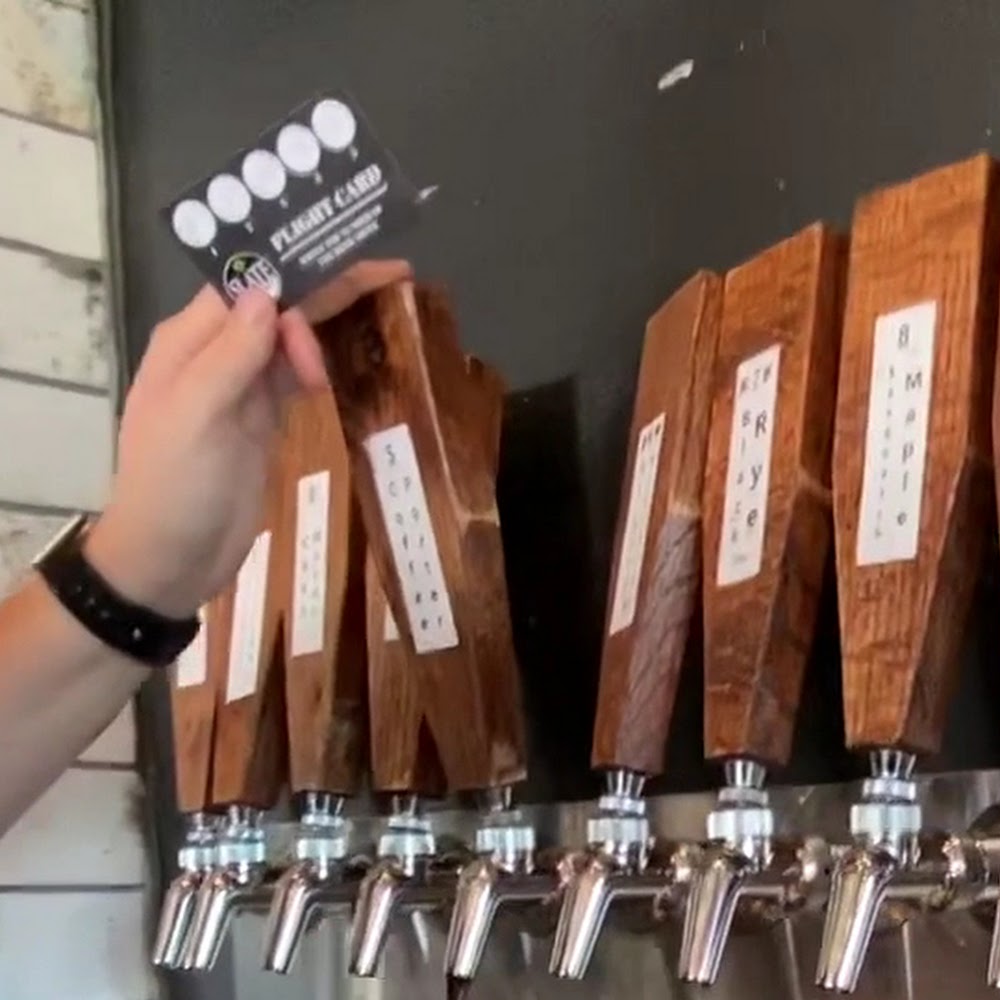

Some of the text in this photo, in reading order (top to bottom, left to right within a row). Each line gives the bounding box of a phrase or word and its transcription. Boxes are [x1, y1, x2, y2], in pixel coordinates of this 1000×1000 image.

[269, 196, 335, 253] FLIGHT
[334, 163, 383, 209] CARD
[745, 408, 768, 528] Rye
